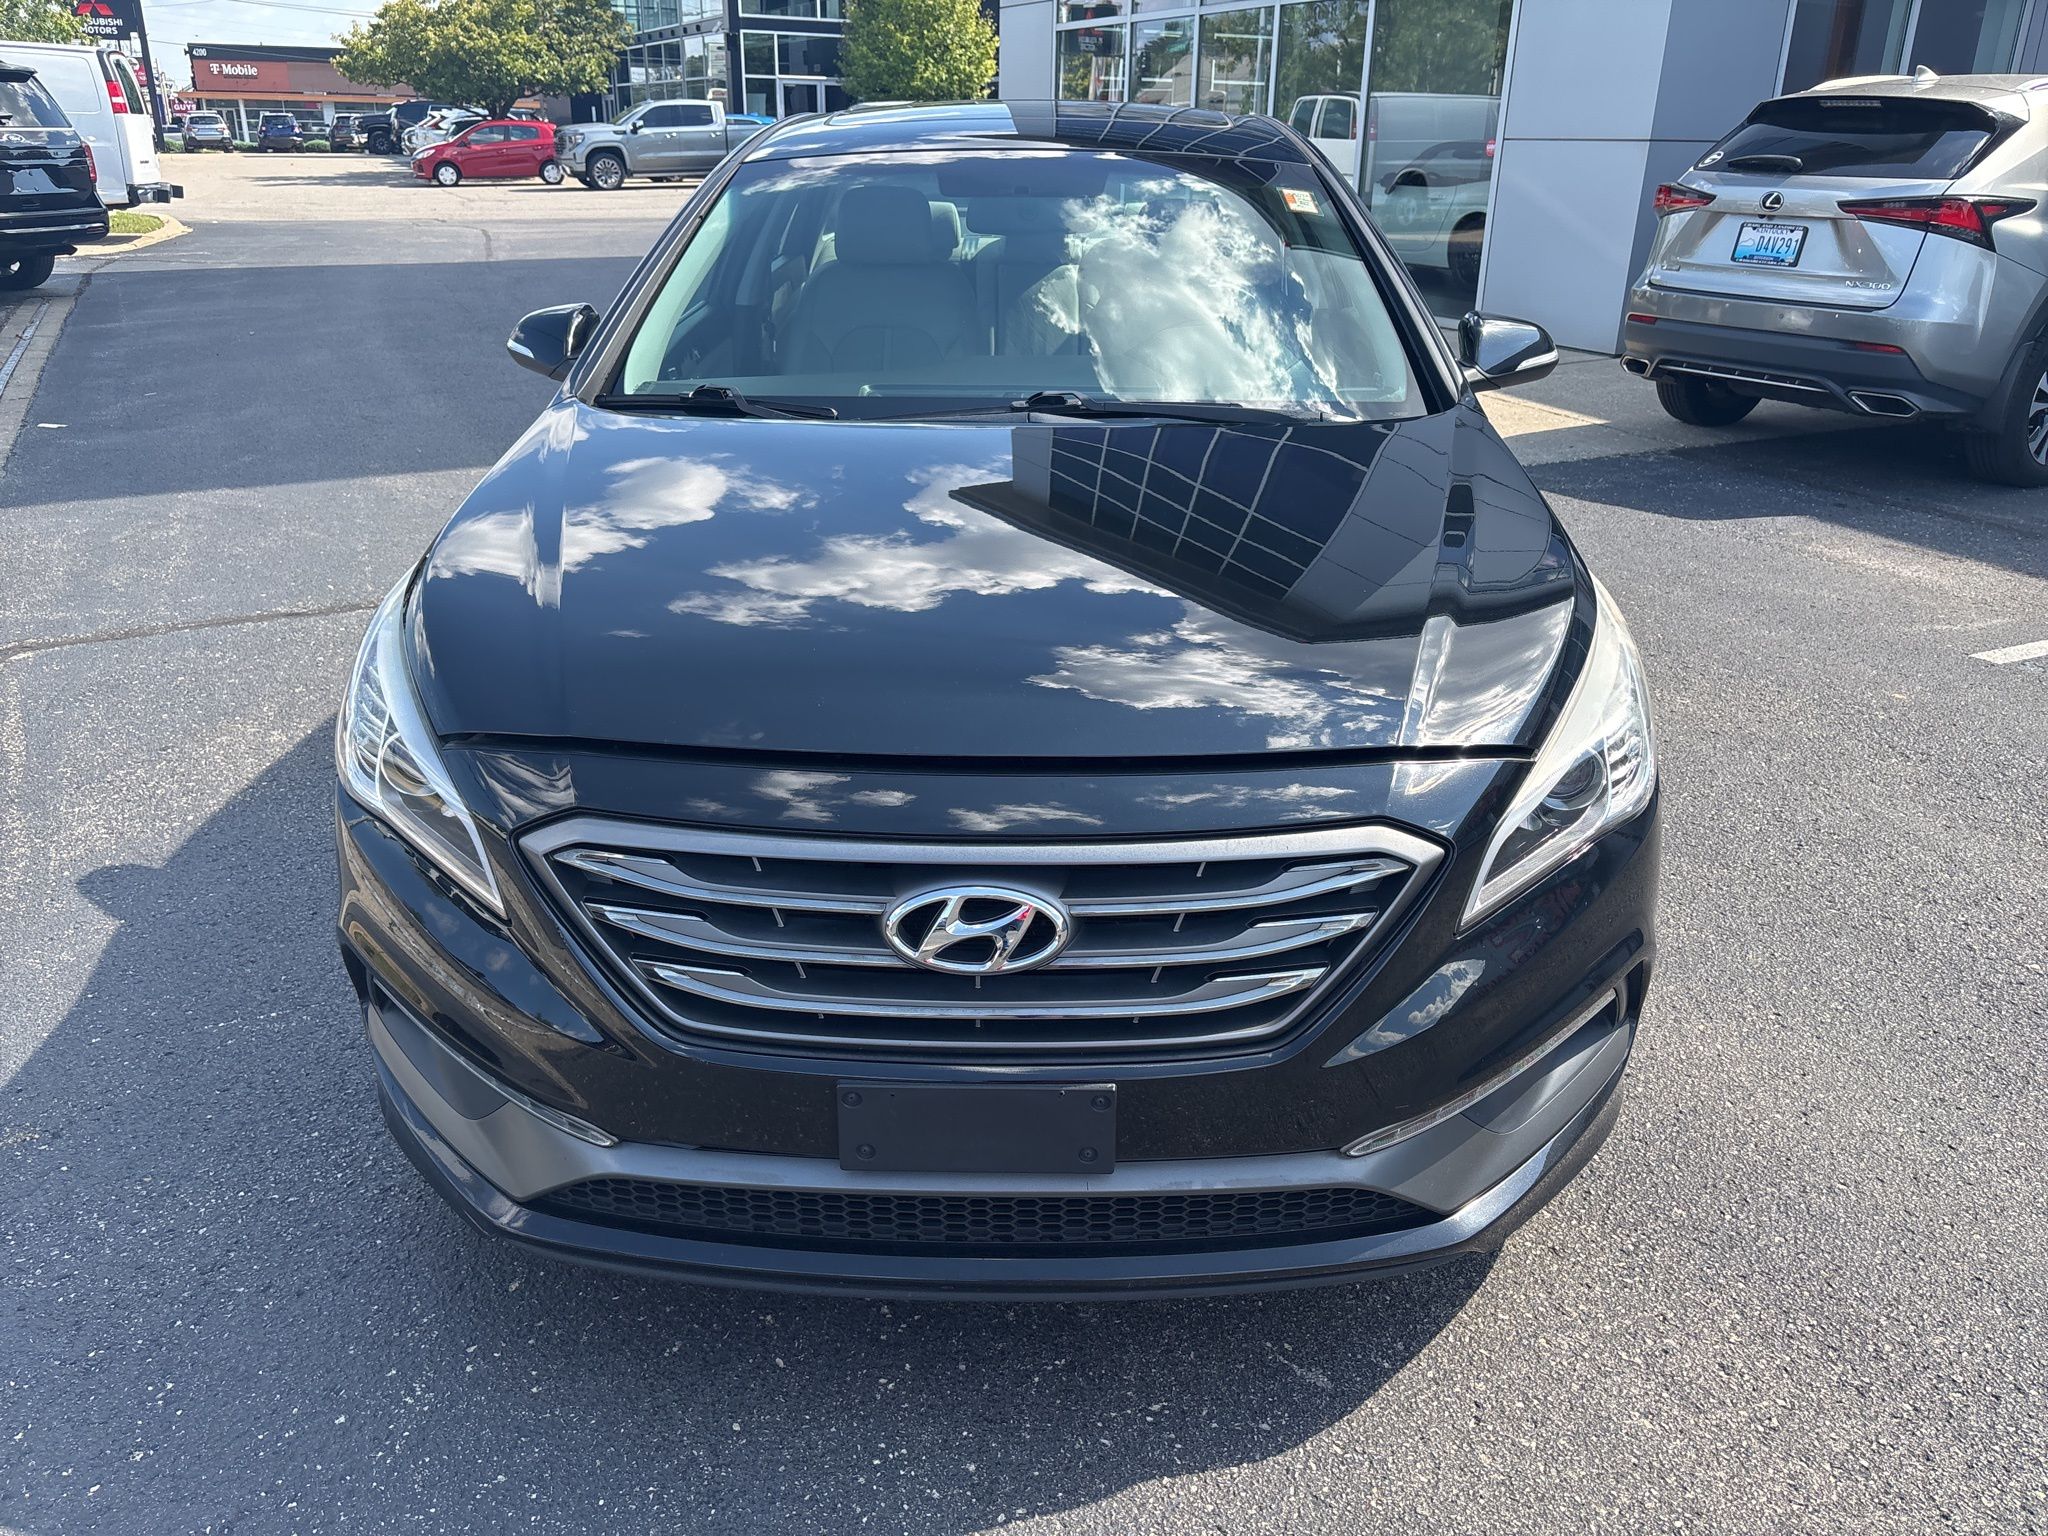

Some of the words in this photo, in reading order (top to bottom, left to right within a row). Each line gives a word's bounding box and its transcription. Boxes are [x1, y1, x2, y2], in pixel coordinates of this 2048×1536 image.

[80, 26, 118, 34] MOTORS
[192, 48, 207, 56] 4200
[221, 64, 258, 76] Mobile
[173, 103, 197, 111] GUYS
